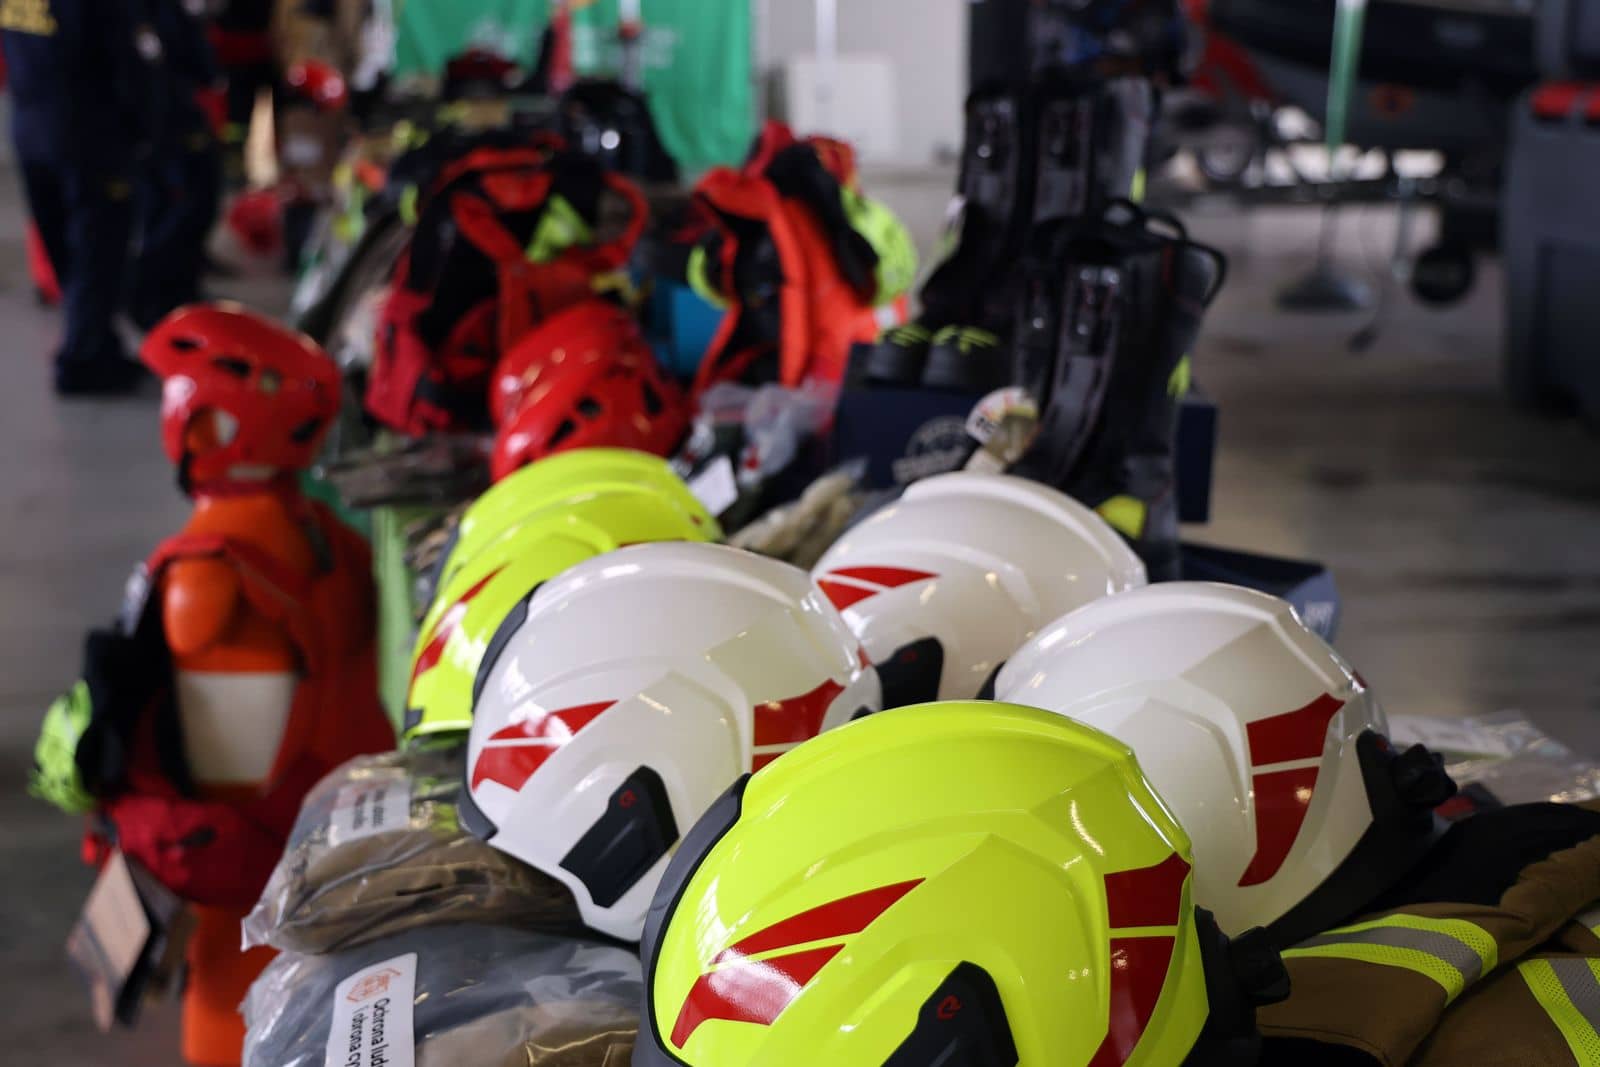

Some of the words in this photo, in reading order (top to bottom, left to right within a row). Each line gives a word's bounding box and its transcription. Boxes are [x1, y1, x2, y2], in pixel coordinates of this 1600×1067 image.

[349, 1013, 369, 1053] obrona
[371, 998, 390, 1045] Ochrona
[371, 1043, 390, 1067] lud
